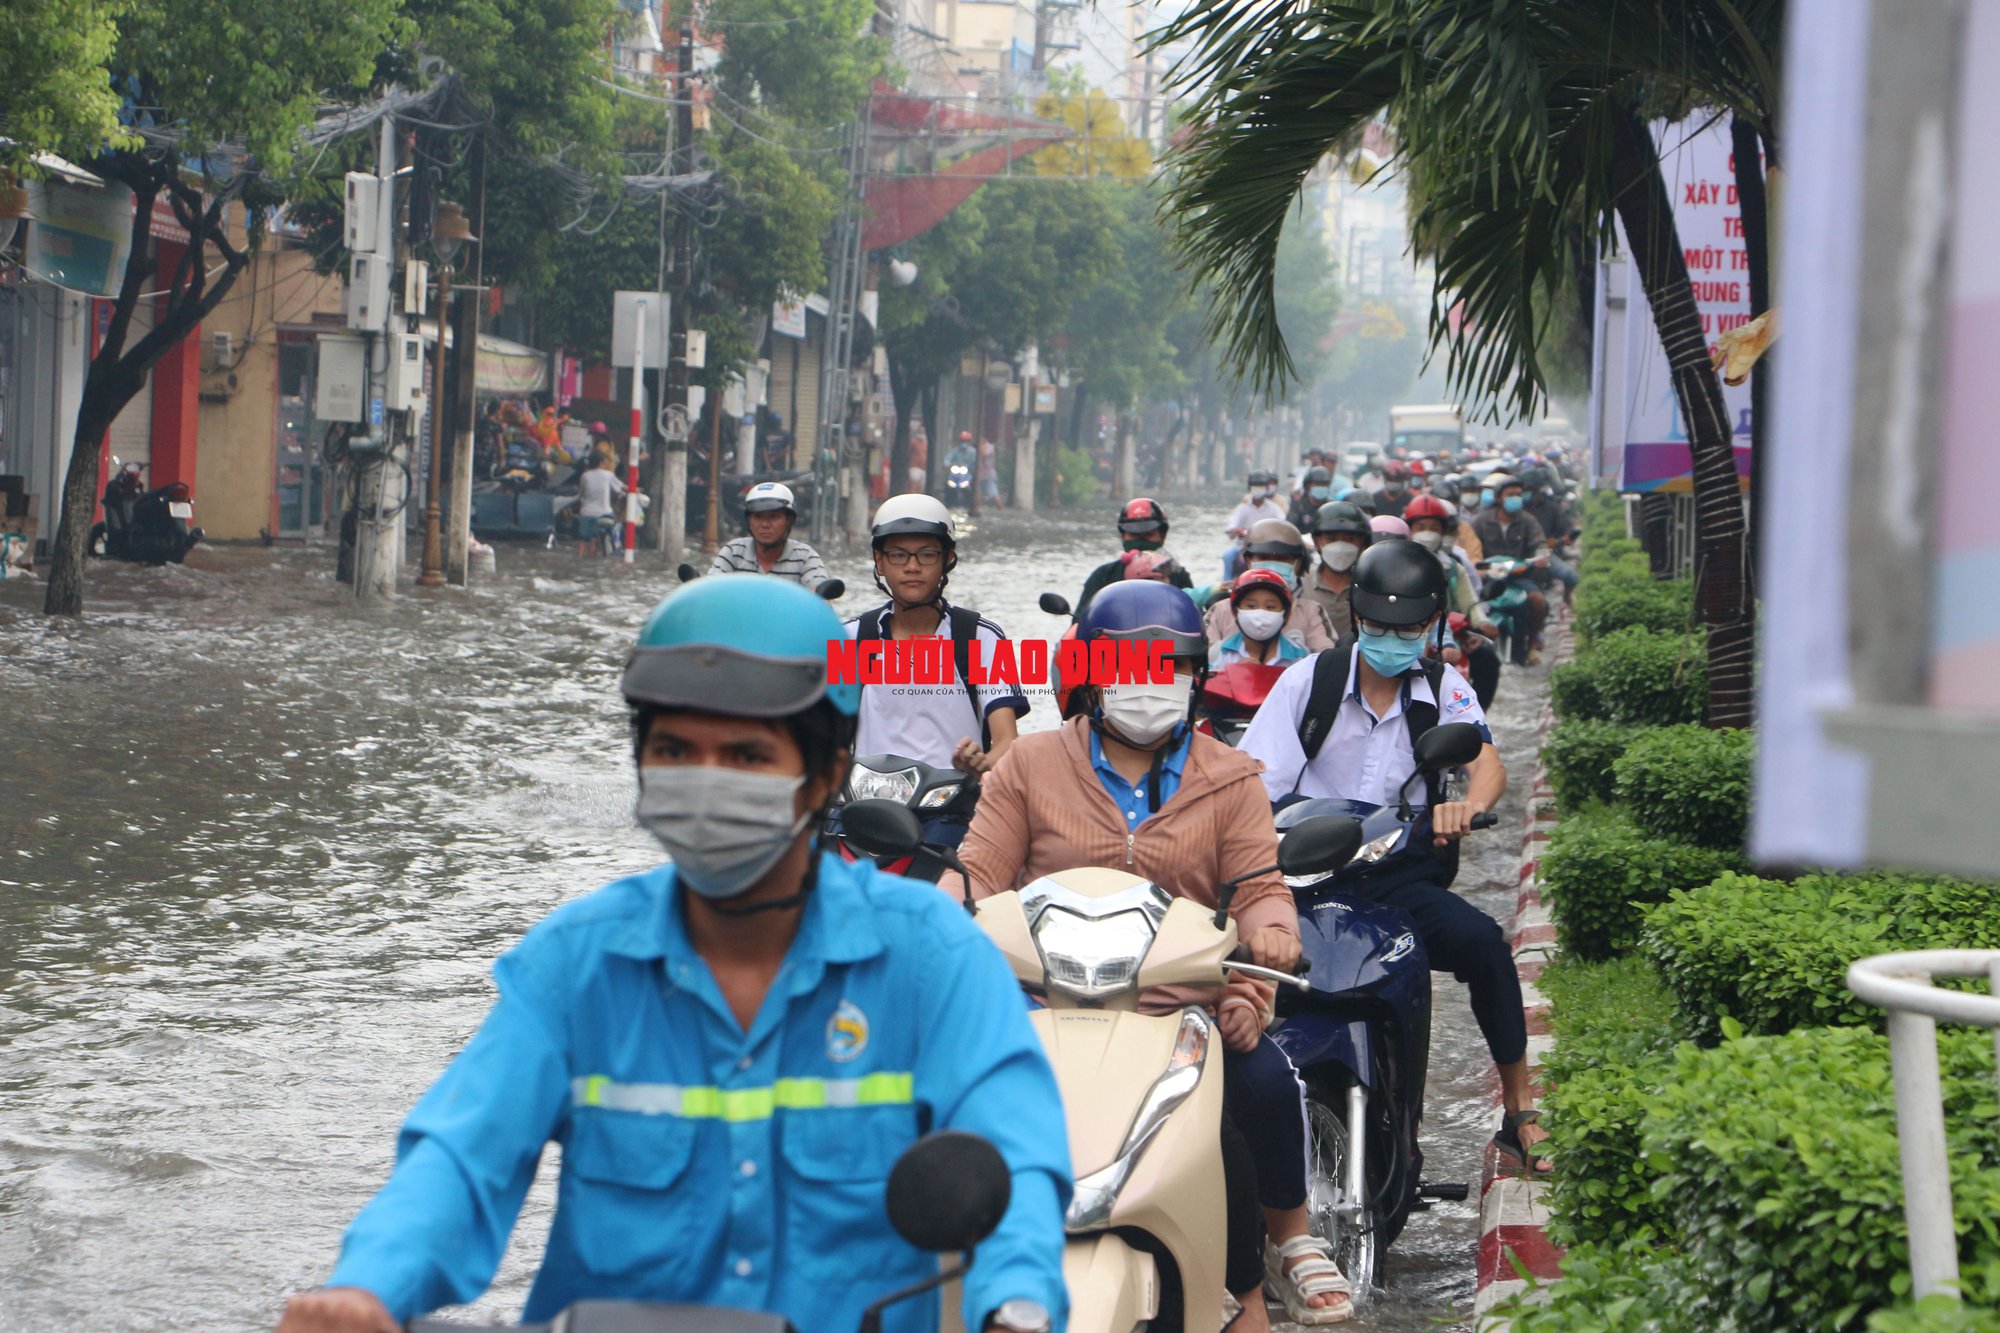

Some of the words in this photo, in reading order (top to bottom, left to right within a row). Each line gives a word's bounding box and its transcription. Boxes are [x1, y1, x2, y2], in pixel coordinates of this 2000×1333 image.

[1684, 180, 1720, 204] XÂY
[1724, 217, 1745, 238] TR
[1684, 245, 1724, 274] MỘT
[1690, 281, 1740, 302] RUNG
[1312, 901, 1353, 912] HONDA
